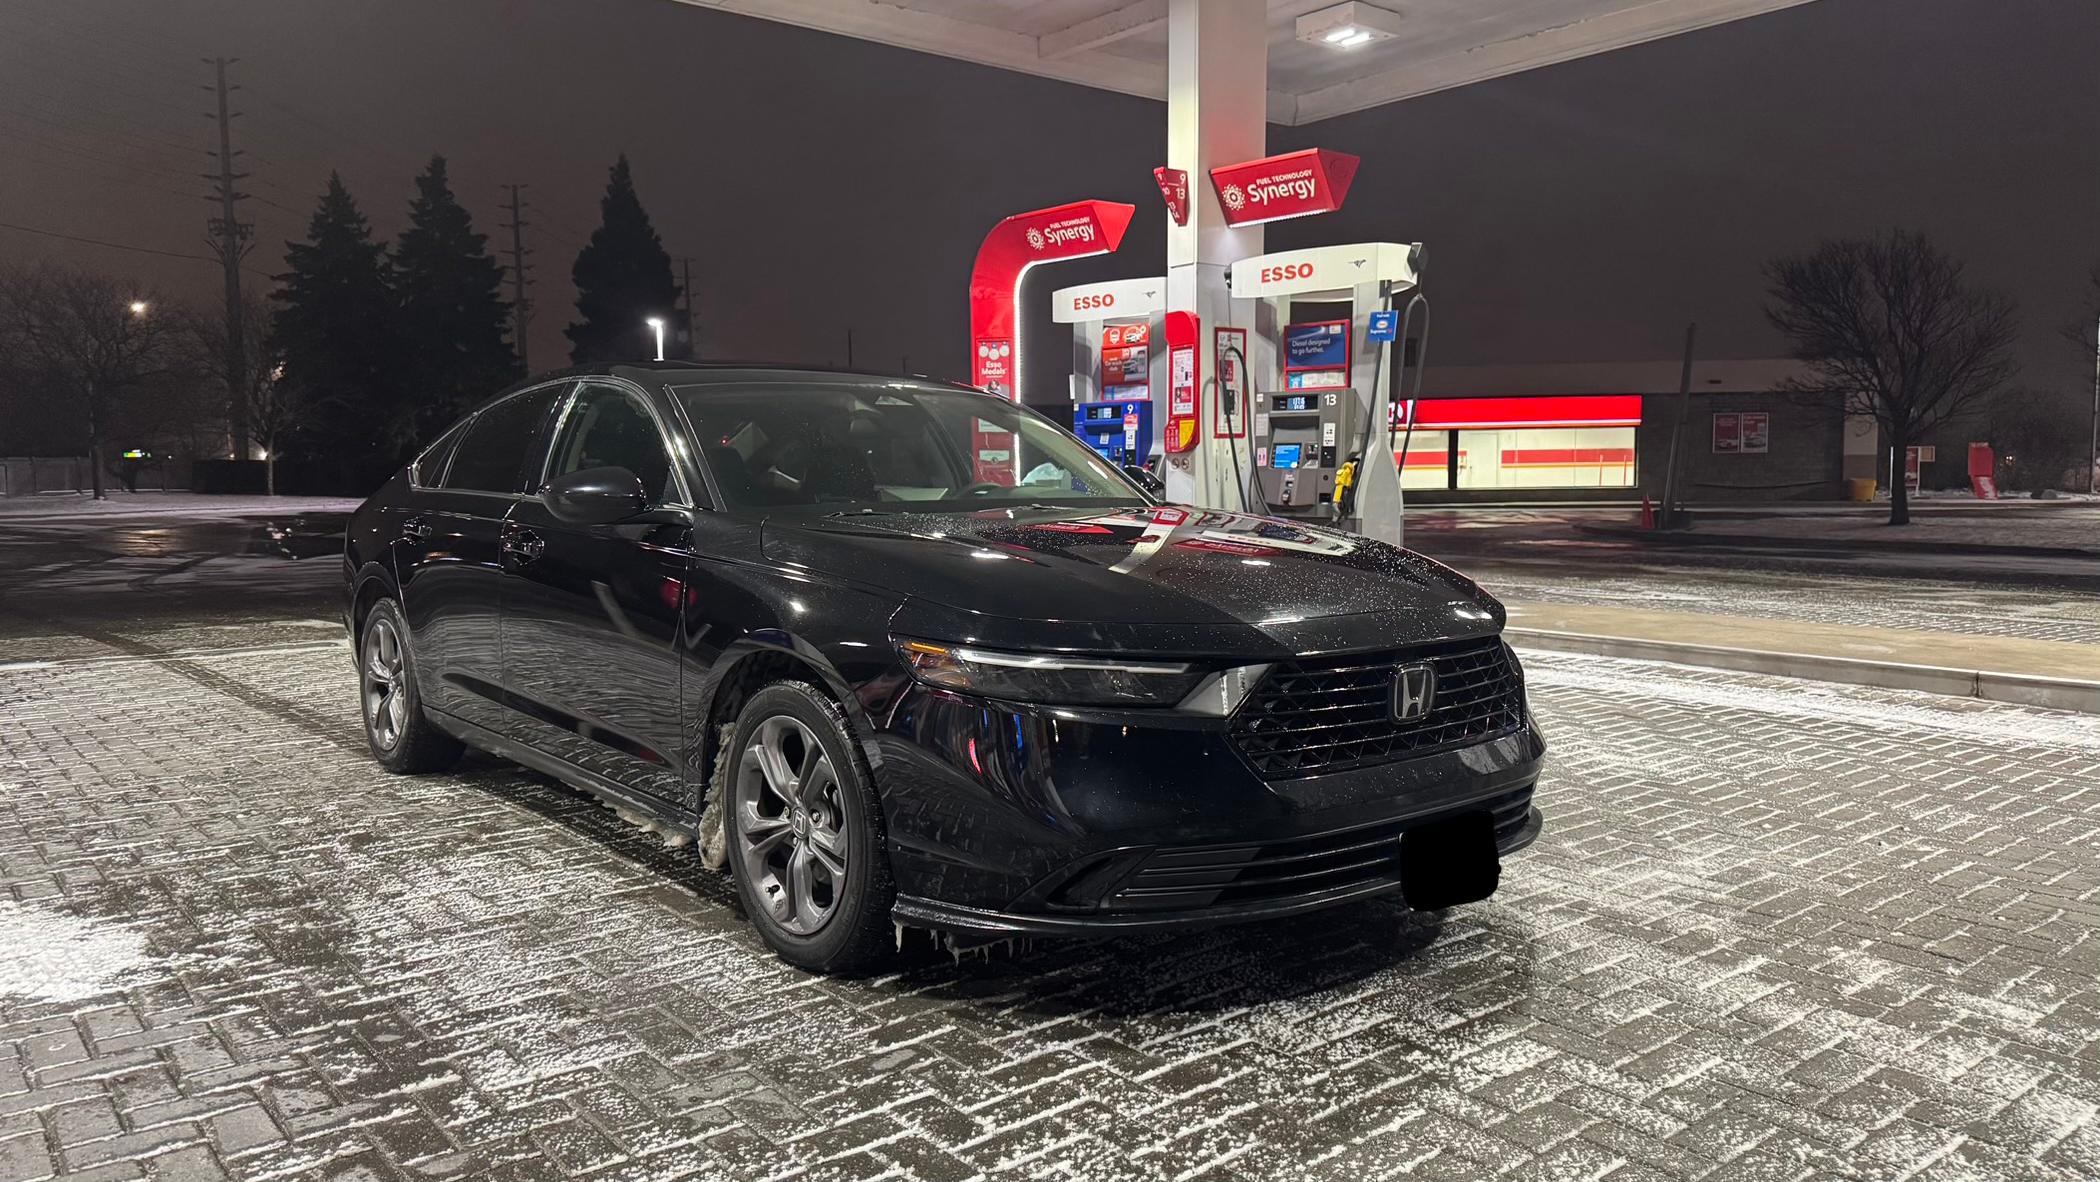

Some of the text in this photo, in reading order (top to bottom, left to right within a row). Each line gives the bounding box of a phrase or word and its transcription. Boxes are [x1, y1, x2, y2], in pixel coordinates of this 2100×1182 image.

[1256, 169, 1313, 185] FUEL TECHNOLOGY
[1176, 188, 1186, 199] 13
[1247, 178, 1315, 206] Synergy
[1061, 216, 1090, 227] TECHNOLOGY
[1044, 224, 1095, 246] Synergy
[1261, 263, 1314, 283] ESSO
[1074, 294, 1114, 310] ESSO
[1308, 338, 1331, 347] designed
[1324, 394, 1336, 406] 13
[1127, 403, 1134, 414] 9
